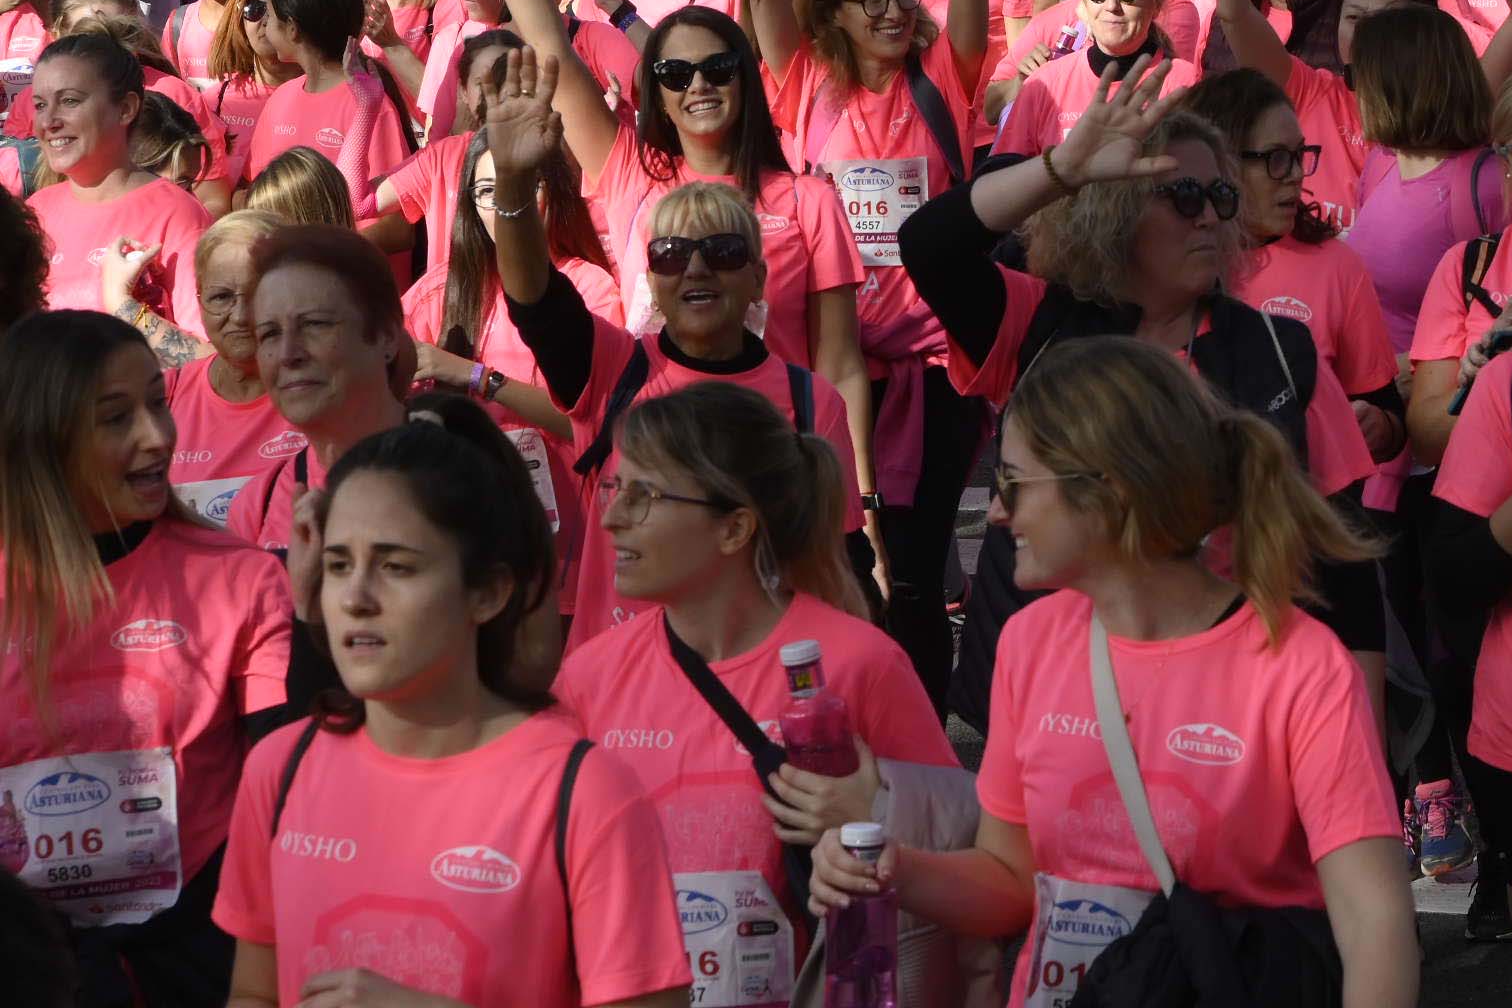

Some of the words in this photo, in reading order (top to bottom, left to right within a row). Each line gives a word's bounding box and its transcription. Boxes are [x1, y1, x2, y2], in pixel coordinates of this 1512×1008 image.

[846, 175, 890, 187] ASTURIANA
[849, 200, 888, 216] 016
[855, 221, 880, 231] 4557
[1263, 303, 1311, 320] ASTURIANA
[116, 632, 181, 646] ASTURIANA
[603, 729, 674, 751] OYSHO
[1172, 735, 1243, 761] ASTURIANA
[118, 774, 158, 786] SUMA
[30, 789, 103, 809] ASTURIANA
[35, 828, 103, 860] 016
[48, 864, 93, 883] 5830
[435, 859, 517, 886] ASTURIANA
[682, 911, 720, 923] RIANA
[1046, 917, 1123, 937] ASTURIANA
